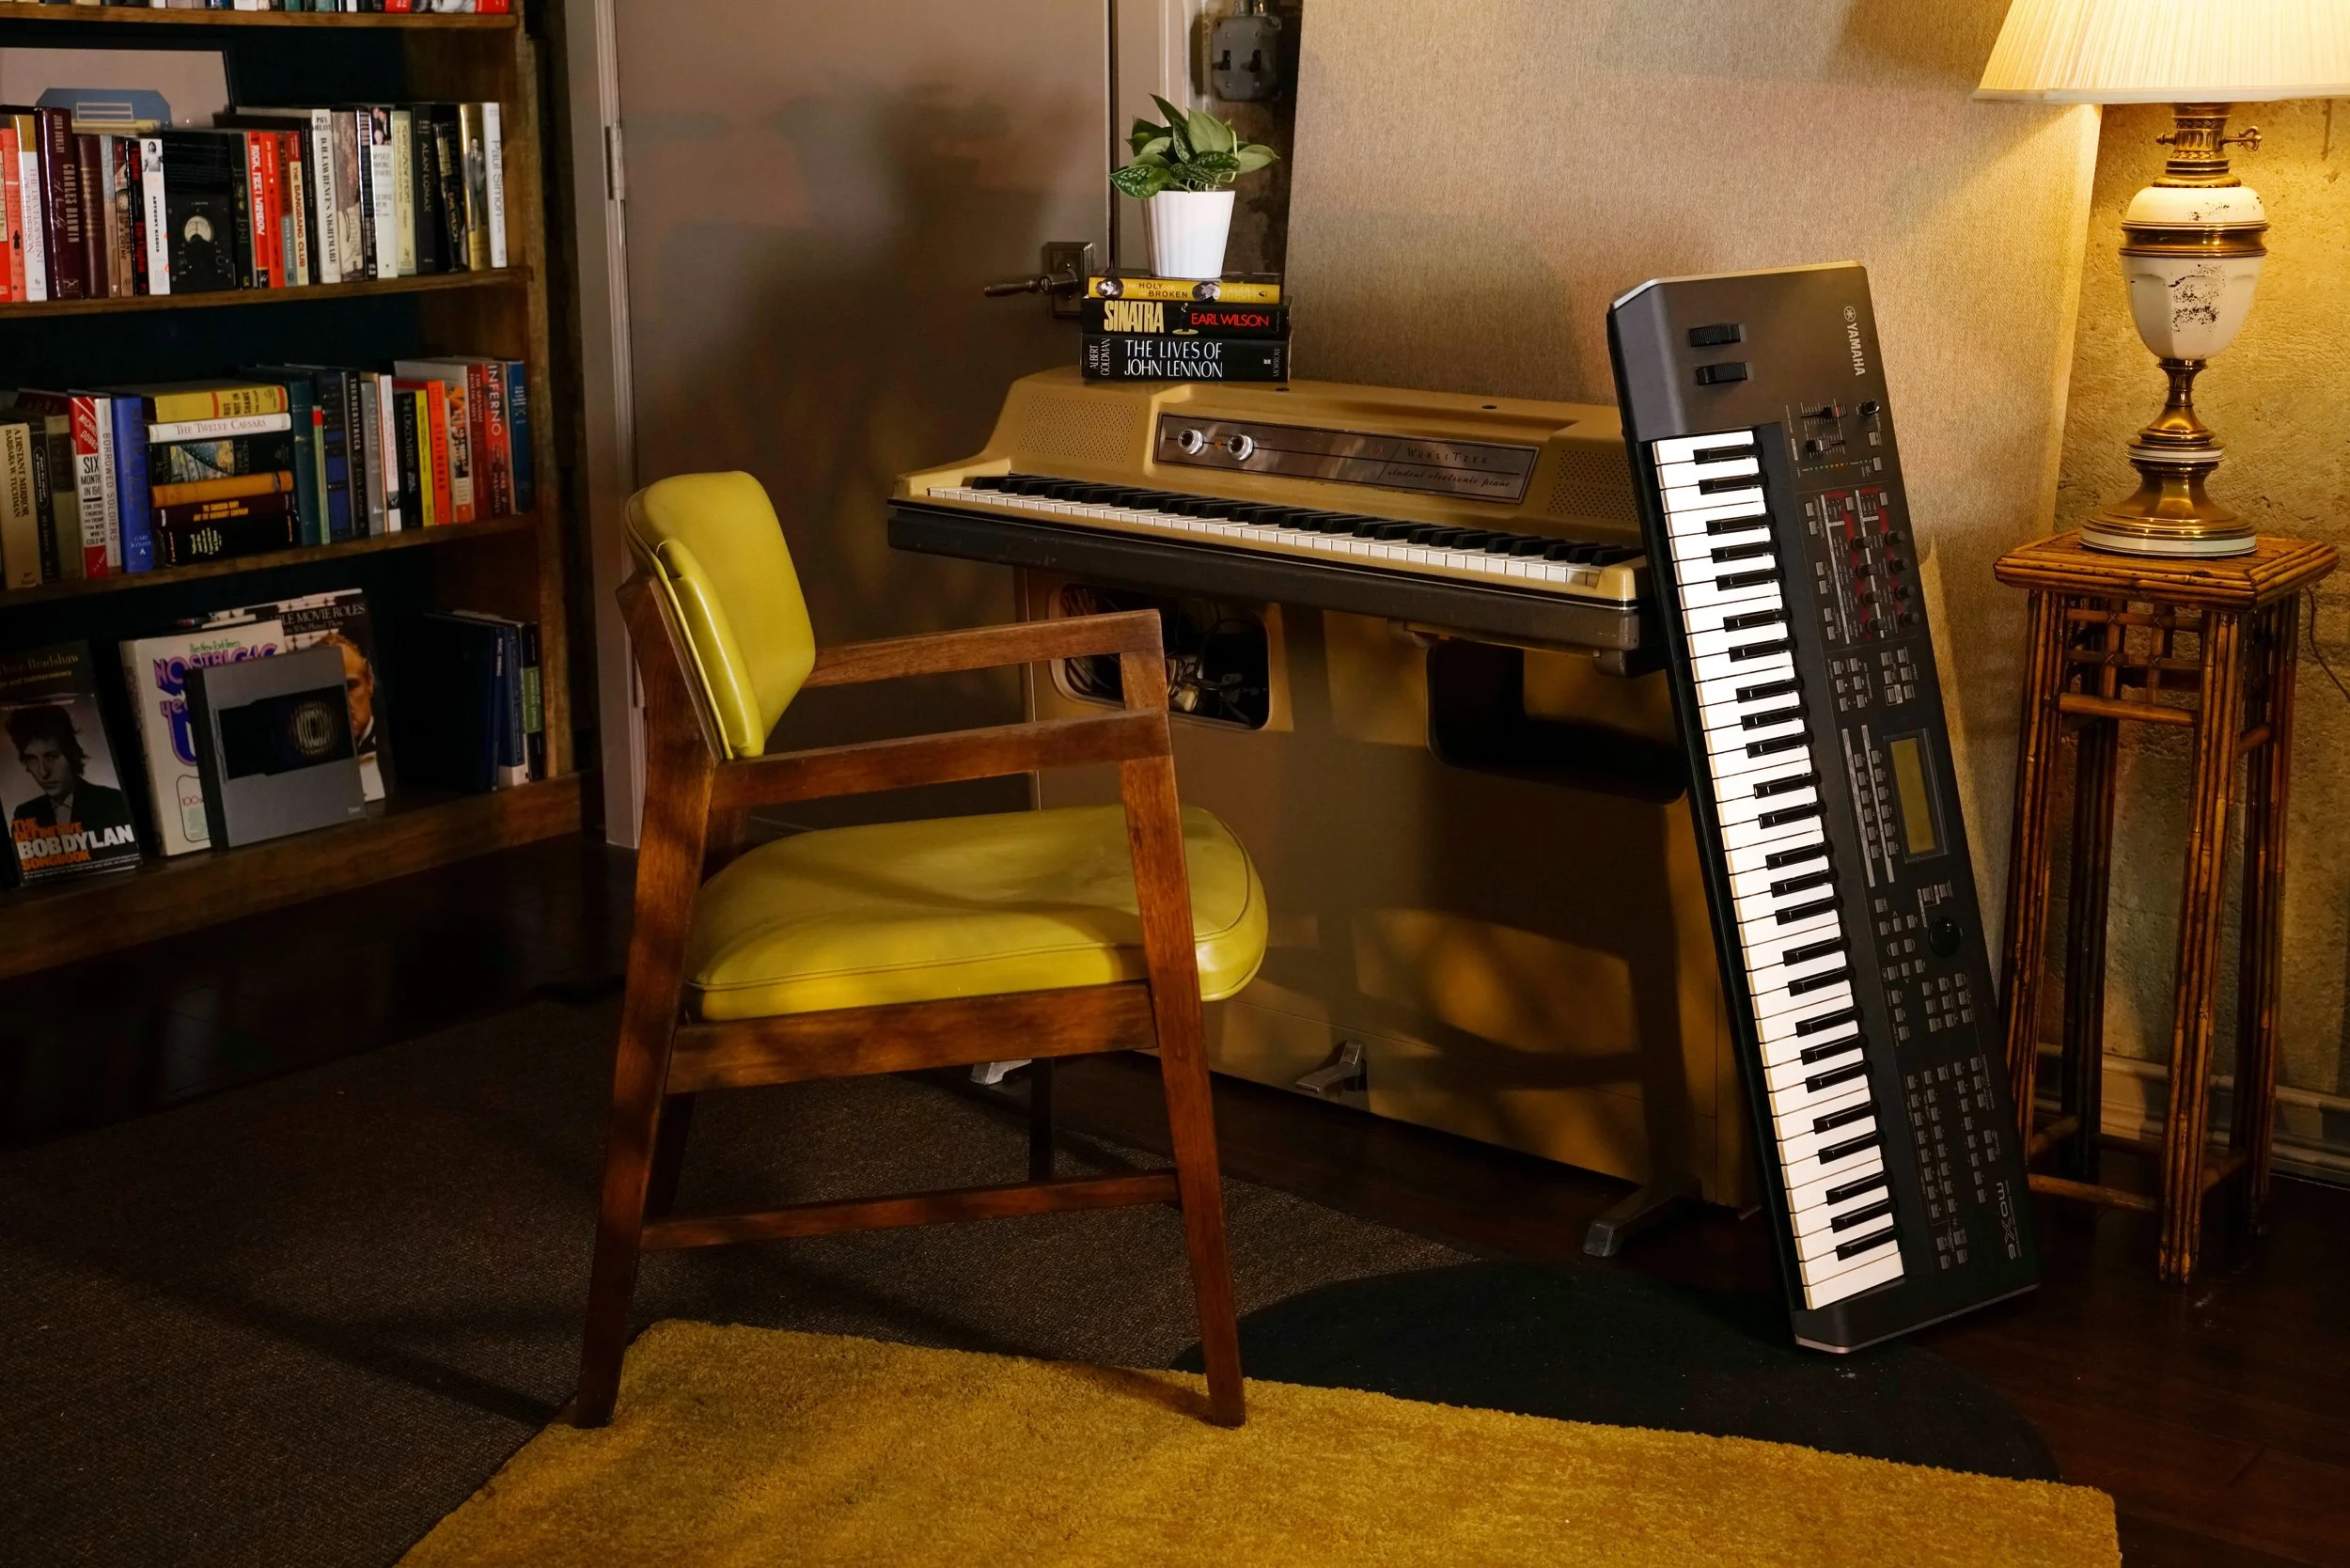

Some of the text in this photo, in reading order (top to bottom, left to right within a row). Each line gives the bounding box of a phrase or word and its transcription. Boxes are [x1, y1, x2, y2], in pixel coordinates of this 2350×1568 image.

[421, 142, 431, 171] ALAN
[252, 171, 263, 195] MEET
[422, 173, 432, 212] LOMAX
[492, 139, 503, 217] Paul Simon
[63, 164, 80, 243] CHARLES DARWIN
[255, 196, 266, 236] WINDOW
[295, 185, 304, 239] BANGBANG
[326, 214, 337, 264] NIGHTMARE
[1149, 290, 1188, 298] BROKEN
[1104, 300, 1165, 334] SINATRA
[1191, 312, 1219, 325] EARL
[1220, 313, 1269, 327] WILSON
[1089, 345, 1099, 369] ALBERT
[1101, 338, 1110, 376] GOLDMAN
[1125, 339, 1222, 359] THE LIVES OF
[1846, 322, 1866, 376] YAMAHA
[1124, 359, 1223, 378] JOHN LENNON
[243, 391, 251, 414] SHAME
[350, 378, 360, 450] THUNDERSTRUCK
[488, 365, 502, 436] INFERNO
[174, 419, 266, 435] THE TWELVE CAESARS
[15, 435, 25, 477] DISTANT
[83, 456, 100, 474] SIX
[433, 423, 446, 491] STALINGRAD
[1406, 447, 1487, 464] WURLITZER
[6, 429, 15, 465] BARBARA
[11, 477, 21, 518] TUCHMAN
[102, 432, 118, 542] BORROWED SOLDIERS
[1387, 467, 1511, 488] student electronic piano
[19, 478, 29, 517] MIRROR
[84, 486, 91, 495] IN
[297, 606, 331, 623] MOVIE
[333, 603, 366, 619] ROLES
[27, 653, 79, 670] Bradshaw
[12, 816, 38, 832] THE
[16, 823, 135, 860] BOB DYLAN
[21, 849, 91, 870] SONGBOOK
